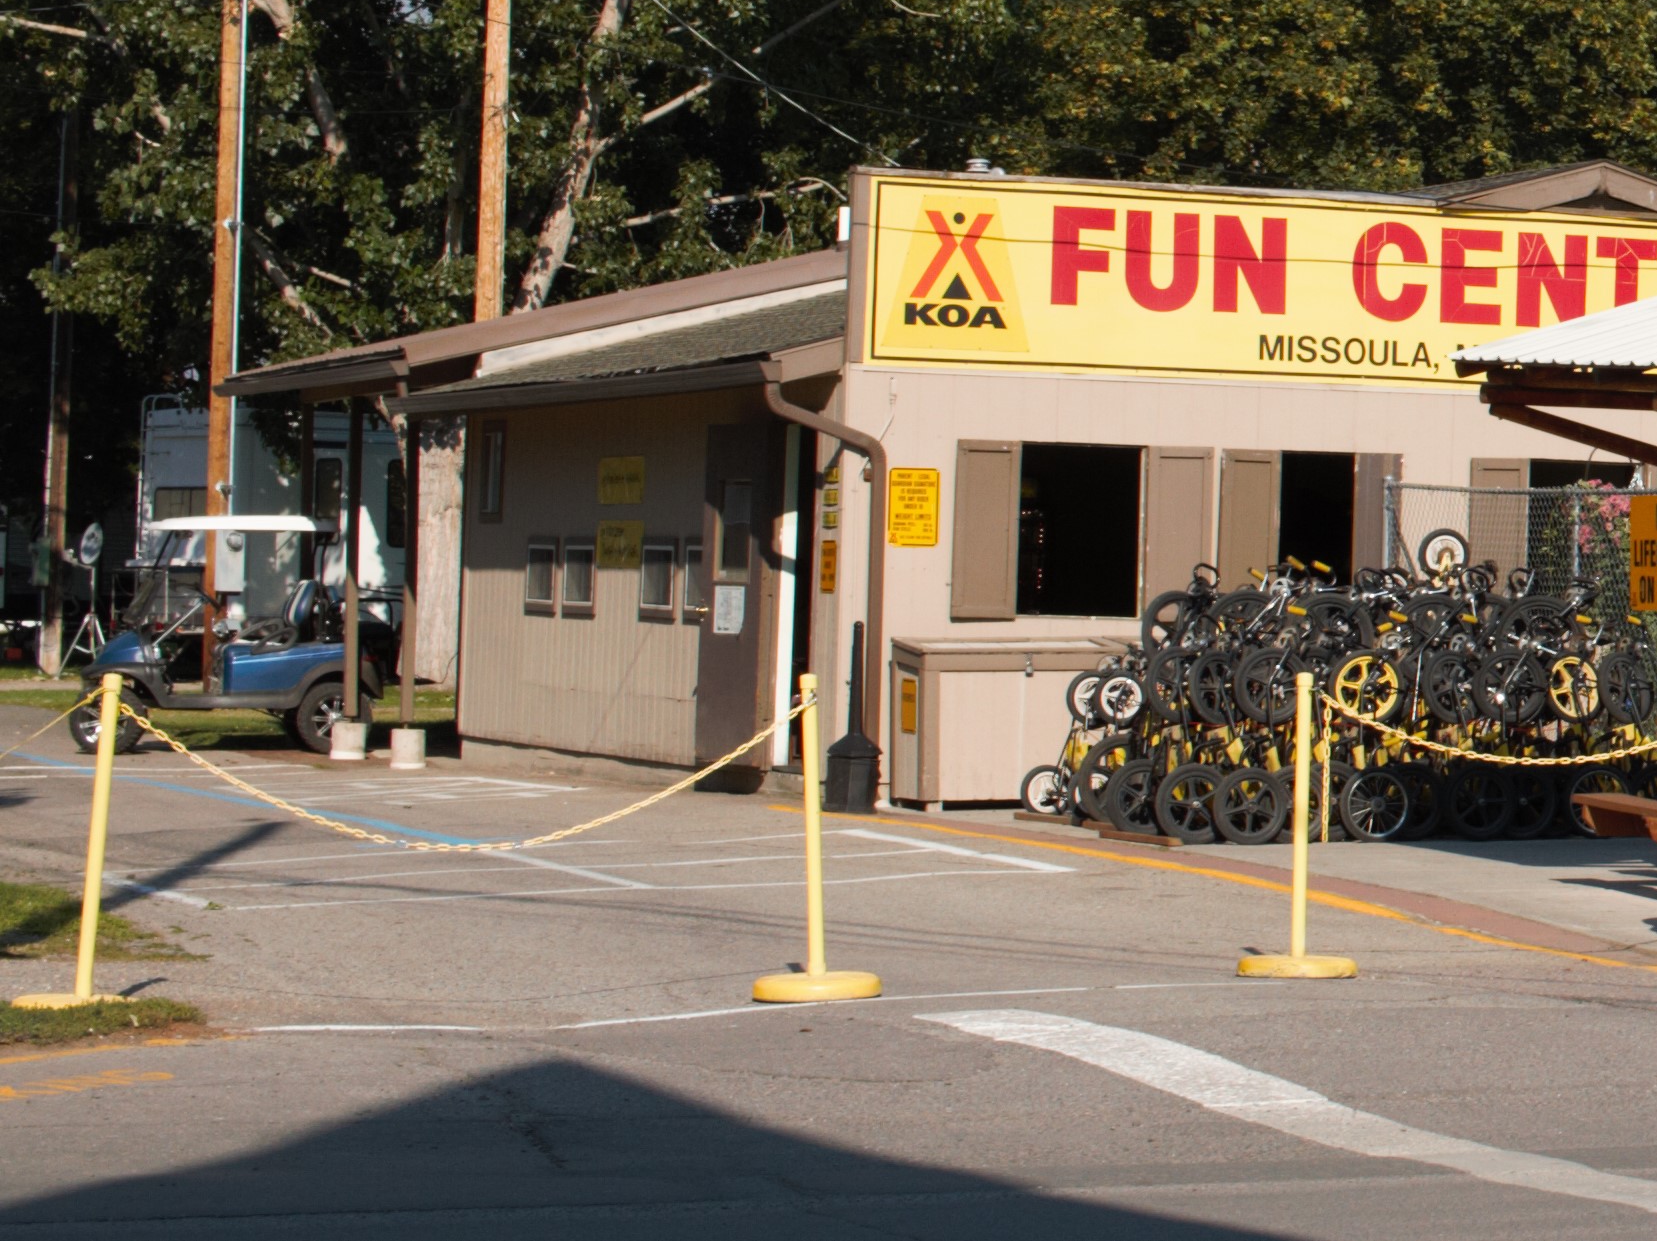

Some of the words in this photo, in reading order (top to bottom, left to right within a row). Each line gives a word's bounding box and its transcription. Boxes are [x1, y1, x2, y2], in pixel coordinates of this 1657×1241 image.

[1050, 205, 1288, 315] FUN
[903, 302, 1008, 330] KOA
[1258, 334, 1440, 374] MISSOULA,
[1639, 575, 1655, 604] ON
